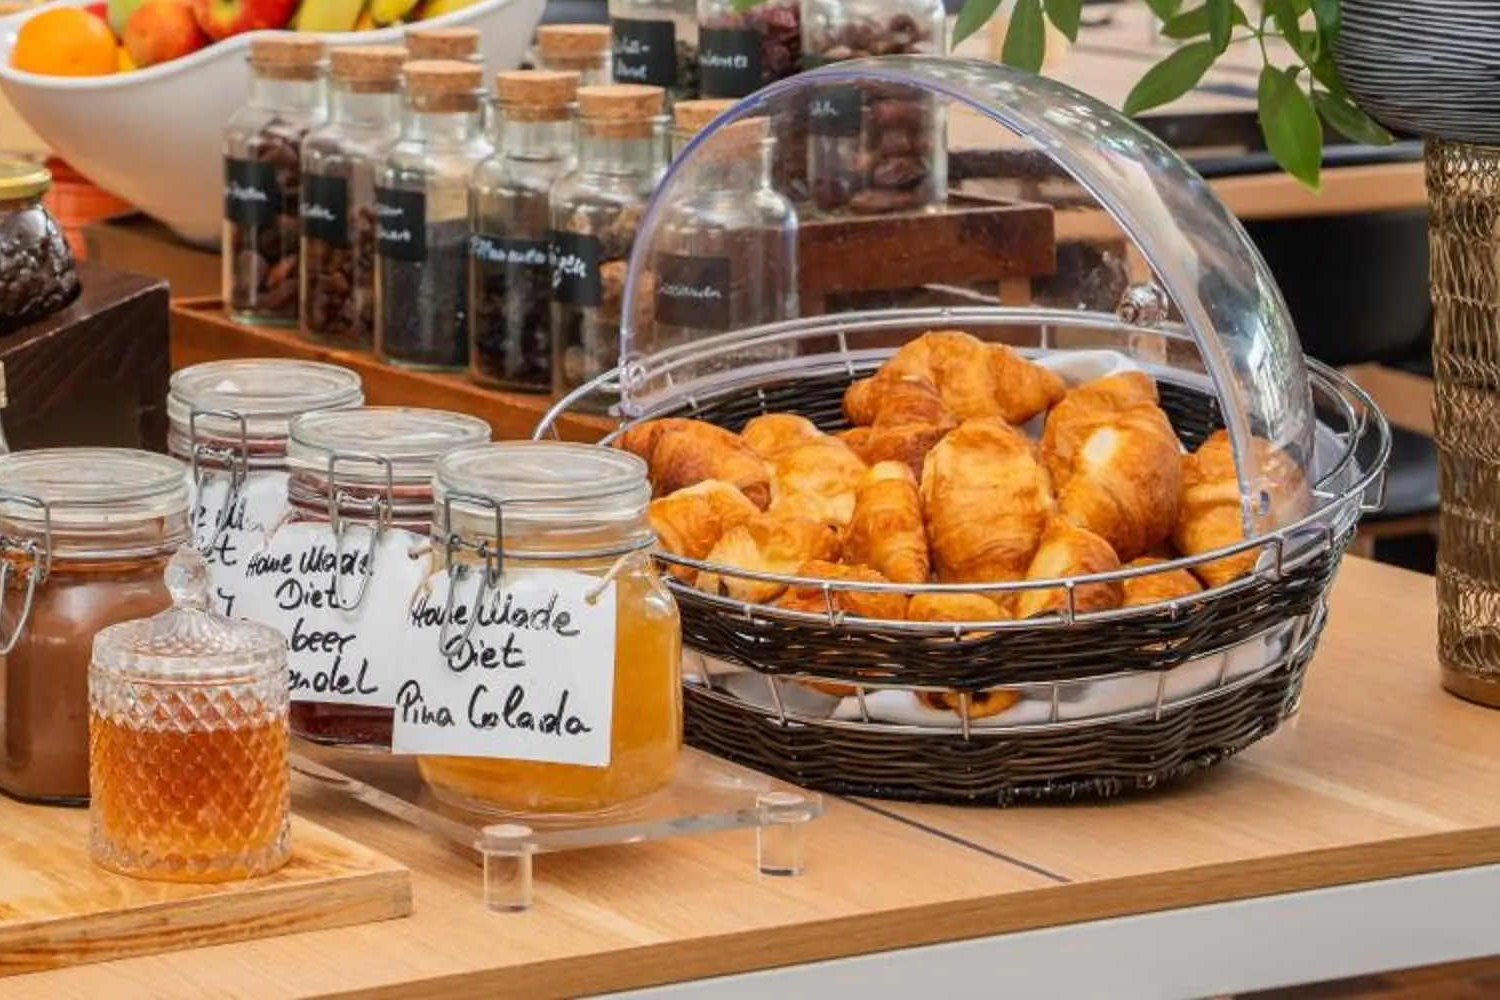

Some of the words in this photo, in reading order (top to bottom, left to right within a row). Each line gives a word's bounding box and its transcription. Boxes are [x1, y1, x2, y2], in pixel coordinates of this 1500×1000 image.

[275, 574, 342, 610] Diet
[285, 617, 357, 655] beer
[445, 631, 526, 673] Diet
[395, 679, 456, 728] Pina
[466, 683, 593, 737] Colada
